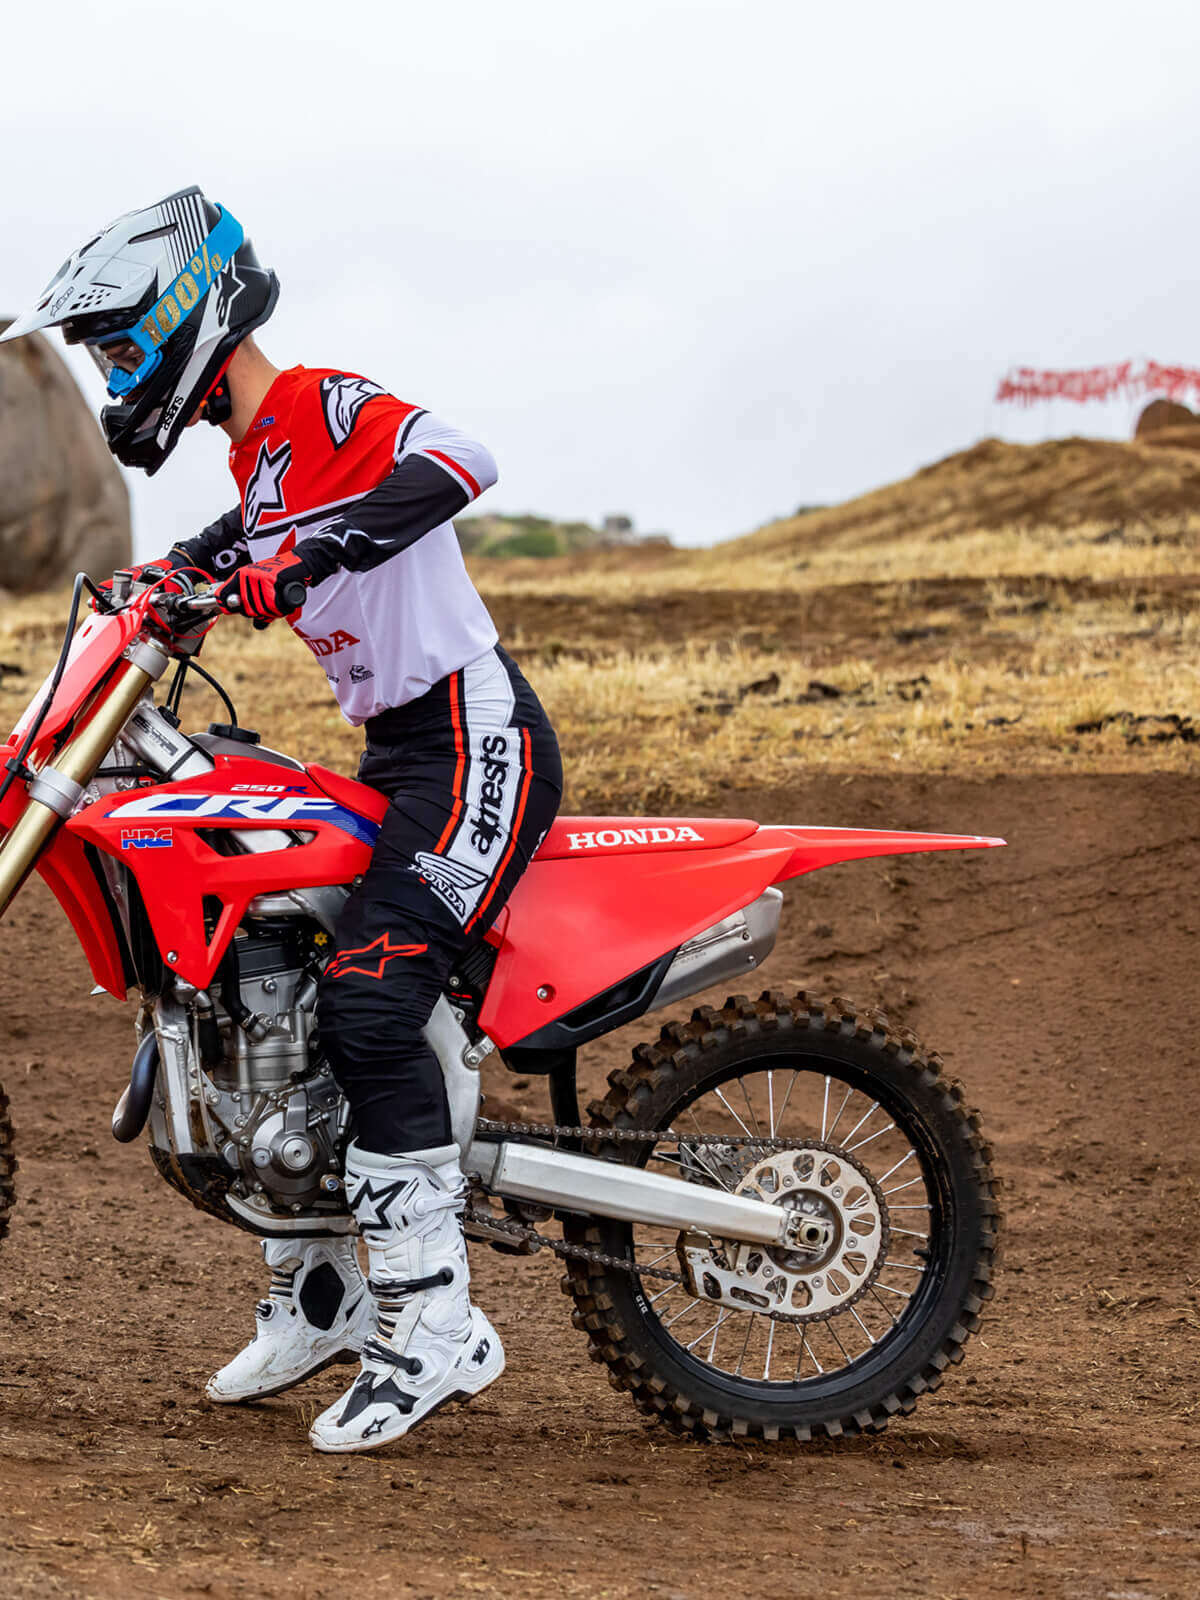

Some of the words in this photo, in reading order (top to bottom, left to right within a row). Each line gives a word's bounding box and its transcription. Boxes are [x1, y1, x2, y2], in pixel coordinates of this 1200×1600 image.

[141, 242, 223, 346] 100%
[230, 784, 311, 795] 250R
[108, 793, 339, 820] CRF
[121, 828, 173, 850] HRC
[567, 826, 704, 850] HONDA
[407, 863, 465, 917] HONDA
